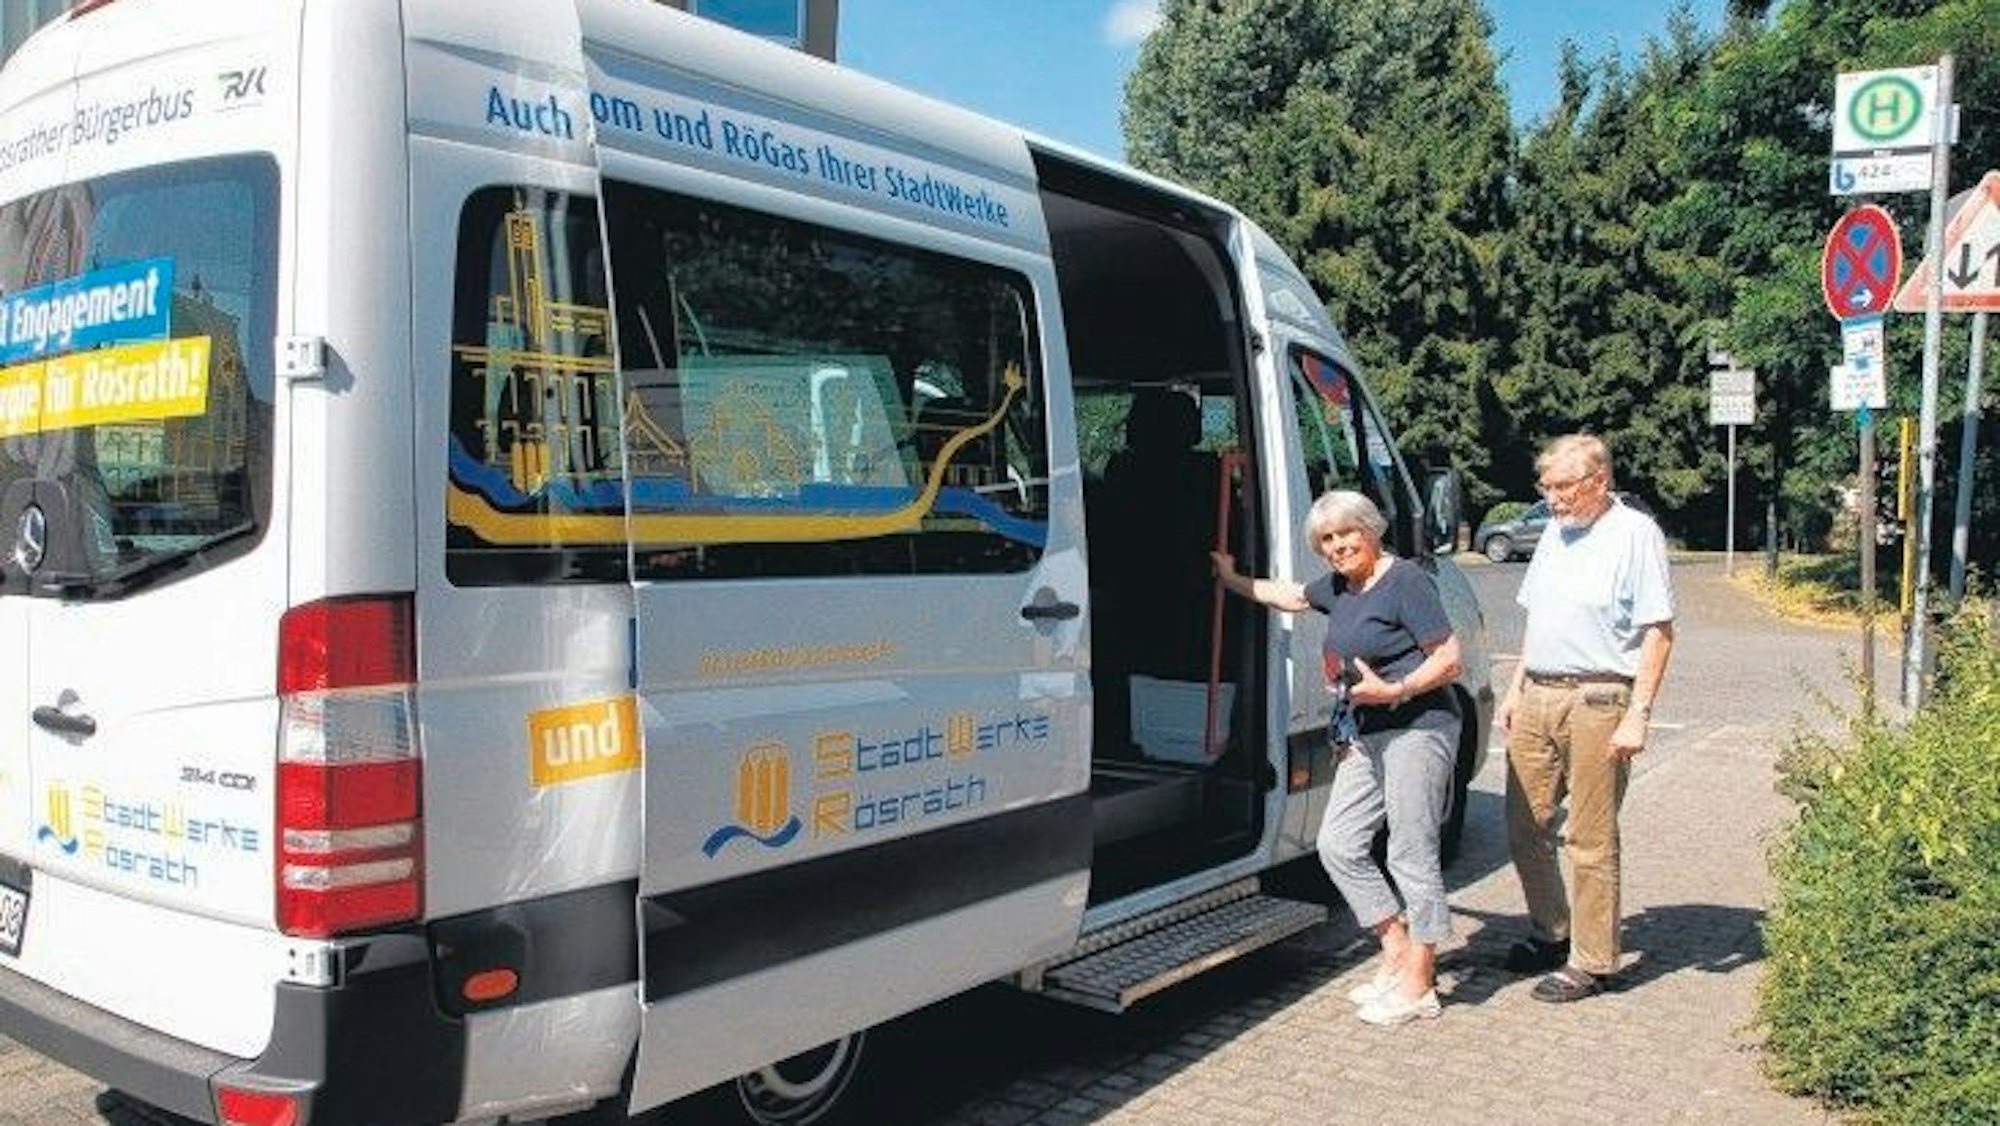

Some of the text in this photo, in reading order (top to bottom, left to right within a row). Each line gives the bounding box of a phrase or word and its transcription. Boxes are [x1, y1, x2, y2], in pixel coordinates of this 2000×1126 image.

[73, 86, 194, 145] Bürgerbus
[1868, 90, 1899, 127] H
[486, 86, 574, 139] Auch
[654, 109, 713, 150] und
[721, 119, 810, 174] RöGas
[817, 144, 877, 192] Ihrer
[884, 166, 1009, 228] StadtWerke
[12, 267, 160, 350] Engagement
[82, 348, 203, 408] Rösrath!
[544, 702, 622, 766] und
[815, 712, 1049, 779] StadtWerke
[813, 773, 986, 839] Rösrath
